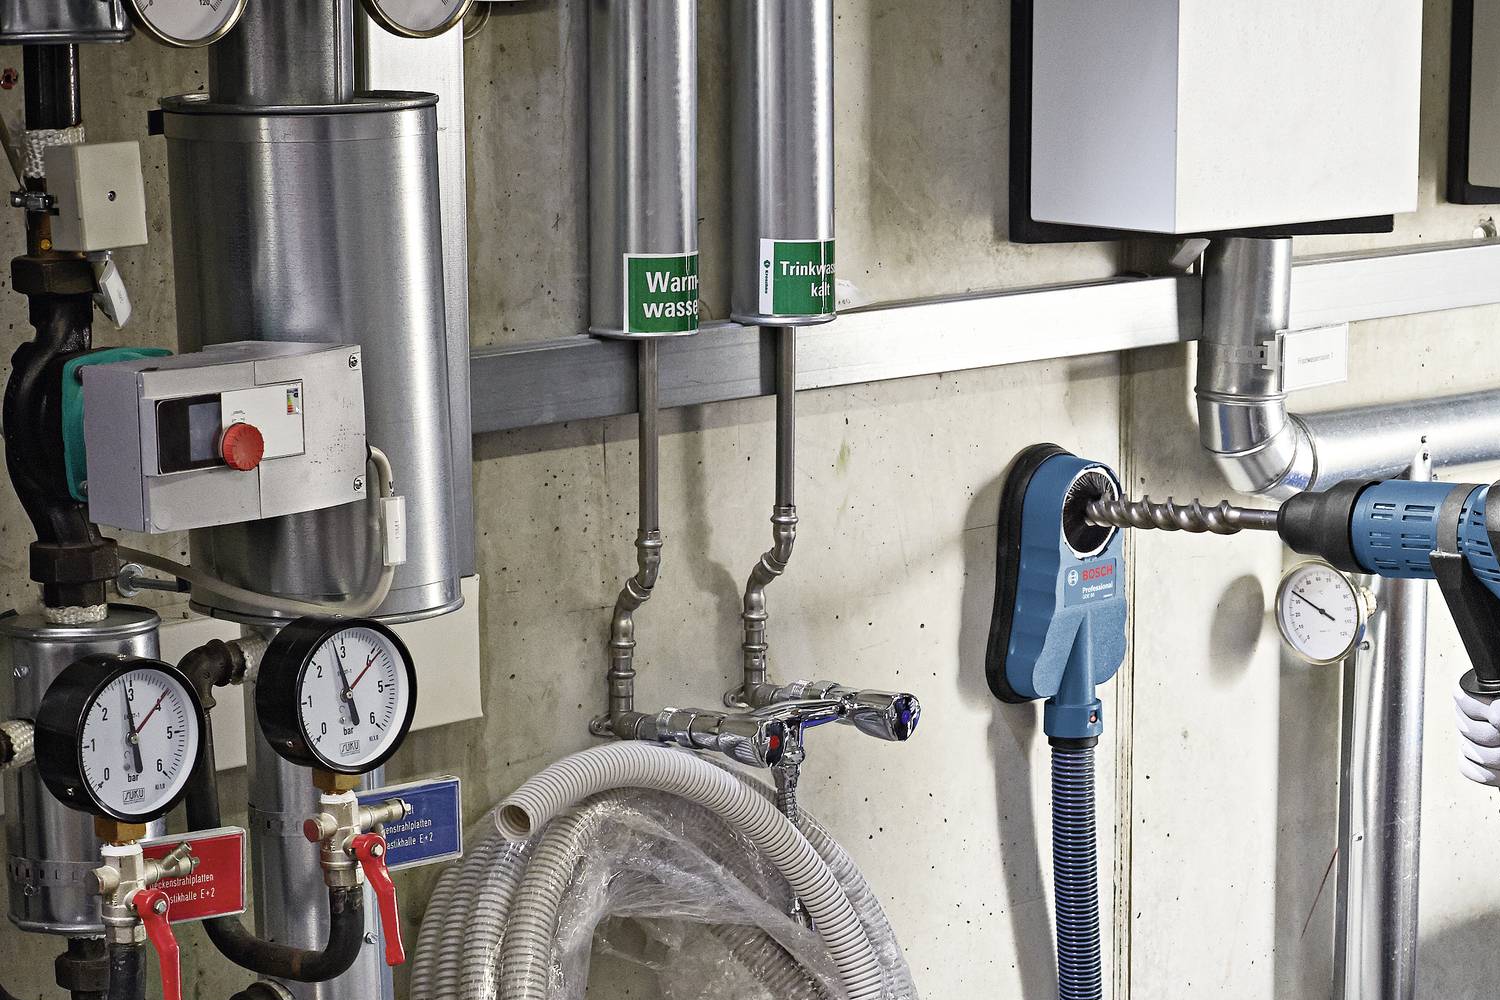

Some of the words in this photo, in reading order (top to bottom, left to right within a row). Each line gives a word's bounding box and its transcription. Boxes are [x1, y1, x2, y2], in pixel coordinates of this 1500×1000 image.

[811, 282, 830, 298] kalt
[1082, 564, 1113, 582] BOSCH
[1082, 580, 1113, 594] Professional
[340, 646, 347, 659] 3
[316, 665, 323, 678] 2
[377, 680, 384, 694] 5
[128, 688, 134, 701] 3
[307, 695, 314, 708] 1
[101, 707, 109, 722] 2
[369, 711, 376, 725] 6
[166, 725, 173, 740] 5
[321, 721, 327, 735] 0
[343, 725, 355, 737] bar
[90, 738, 96, 752] 1
[156, 758, 164, 773] 6
[103, 767, 110, 781] 0
[127, 772, 140, 783] bar
[419, 833, 424, 844] E
[429, 832, 434, 843] 2
[200, 888, 206, 899] E
[210, 887, 216, 898] 2
